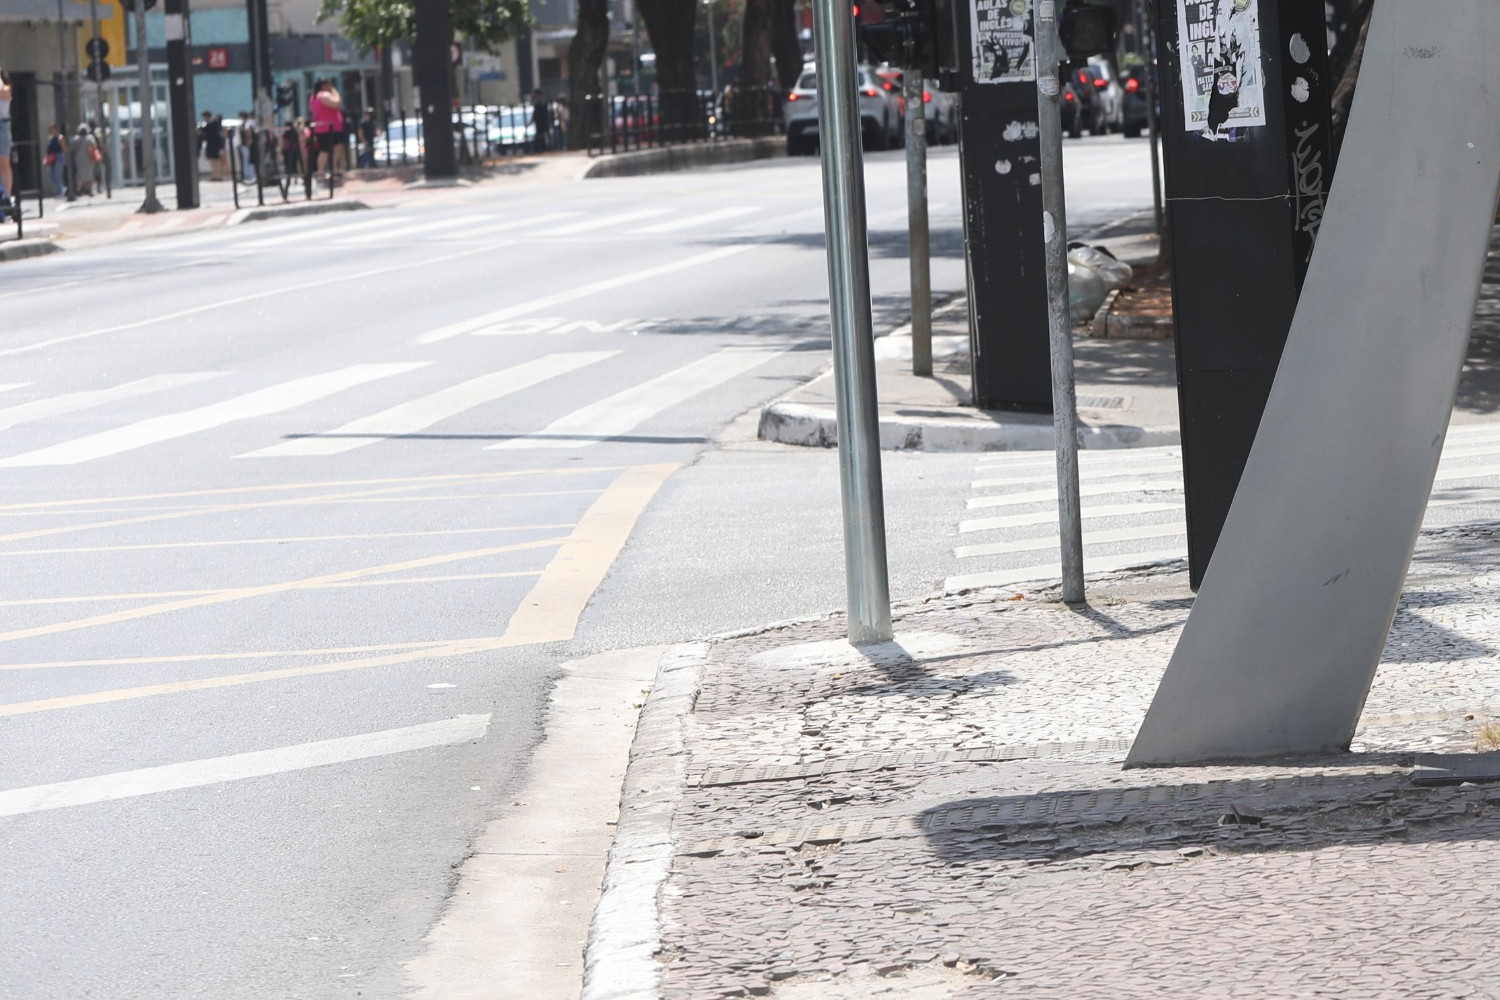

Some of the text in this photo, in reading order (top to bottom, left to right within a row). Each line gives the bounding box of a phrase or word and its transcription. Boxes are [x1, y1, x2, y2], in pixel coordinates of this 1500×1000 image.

[988, 9, 1000, 20] DE
[1199, 2, 1214, 21] DE
[980, 16, 1012, 31] INGLÊS
